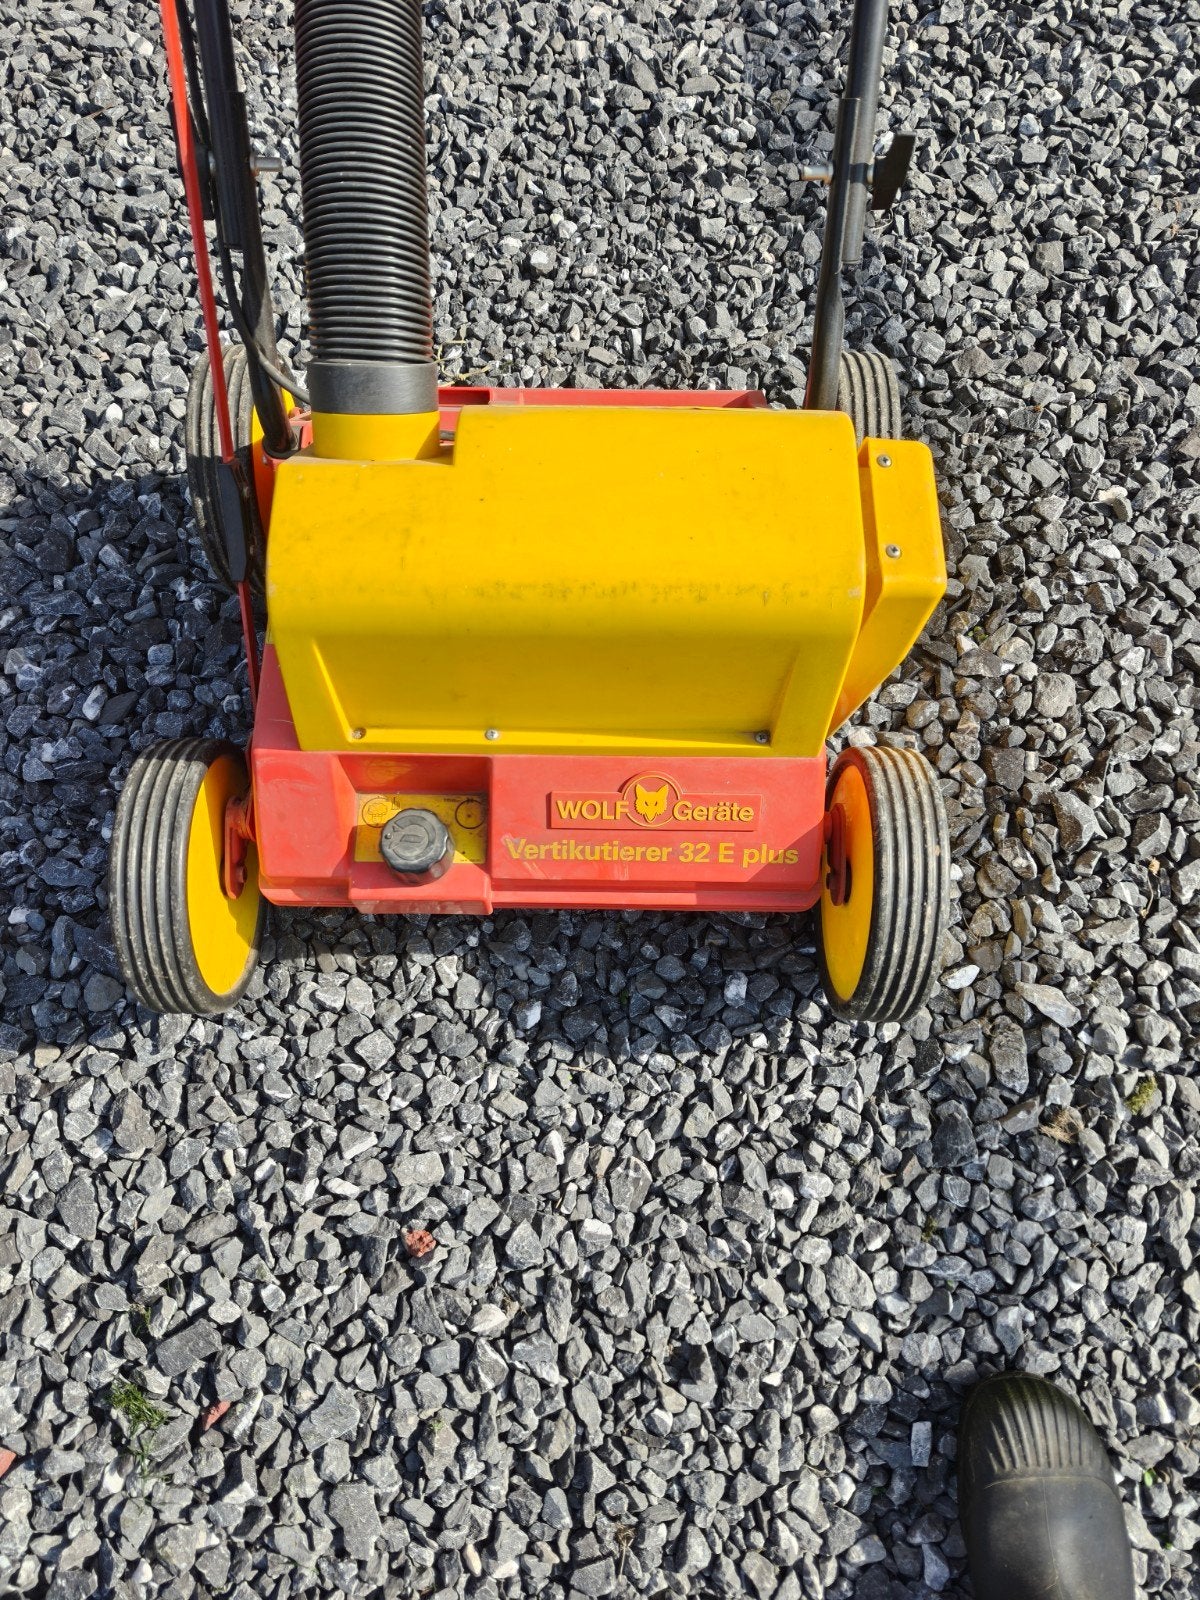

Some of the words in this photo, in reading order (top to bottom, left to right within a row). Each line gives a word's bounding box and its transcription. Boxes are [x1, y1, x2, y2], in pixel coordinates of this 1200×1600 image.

[555, 799, 629, 821] WOLF
[672, 801, 755, 822] Geräte
[505, 838, 672, 862] Vertikutierer
[678, 842, 710, 863] 32
[718, 842, 735, 863] E
[742, 843, 799, 868] plus
